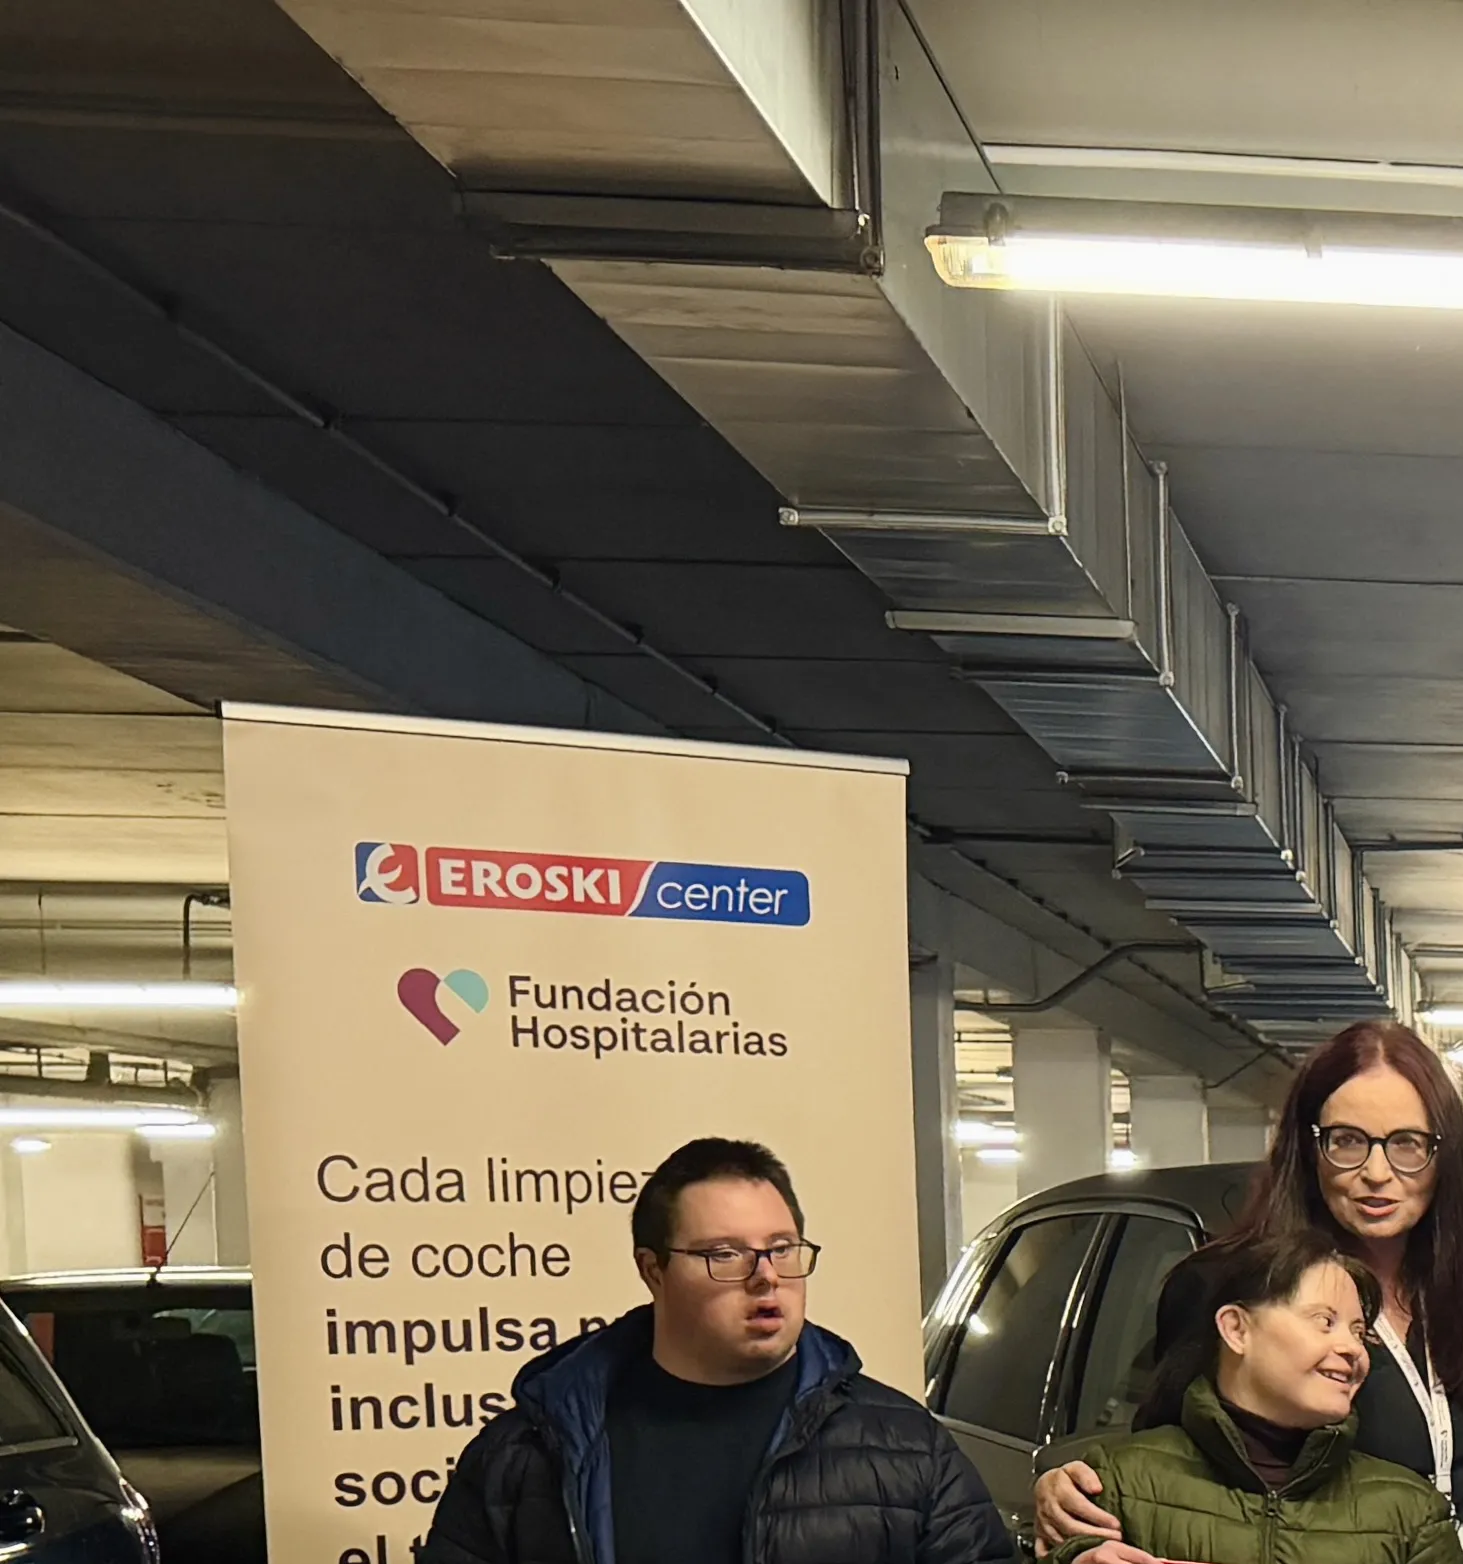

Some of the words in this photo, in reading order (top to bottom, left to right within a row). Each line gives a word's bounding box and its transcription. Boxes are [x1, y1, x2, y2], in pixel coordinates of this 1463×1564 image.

[437, 857, 621, 905] EROSKI
[656, 877, 790, 916] center
[508, 974, 731, 1016] Fundación
[510, 1014, 788, 1059] Hospitalarias
[316, 1154, 466, 1204] Cada
[320, 1232, 390, 1278] de
[411, 1230, 572, 1277] coche
[326, 1307, 558, 1365] impulsa
